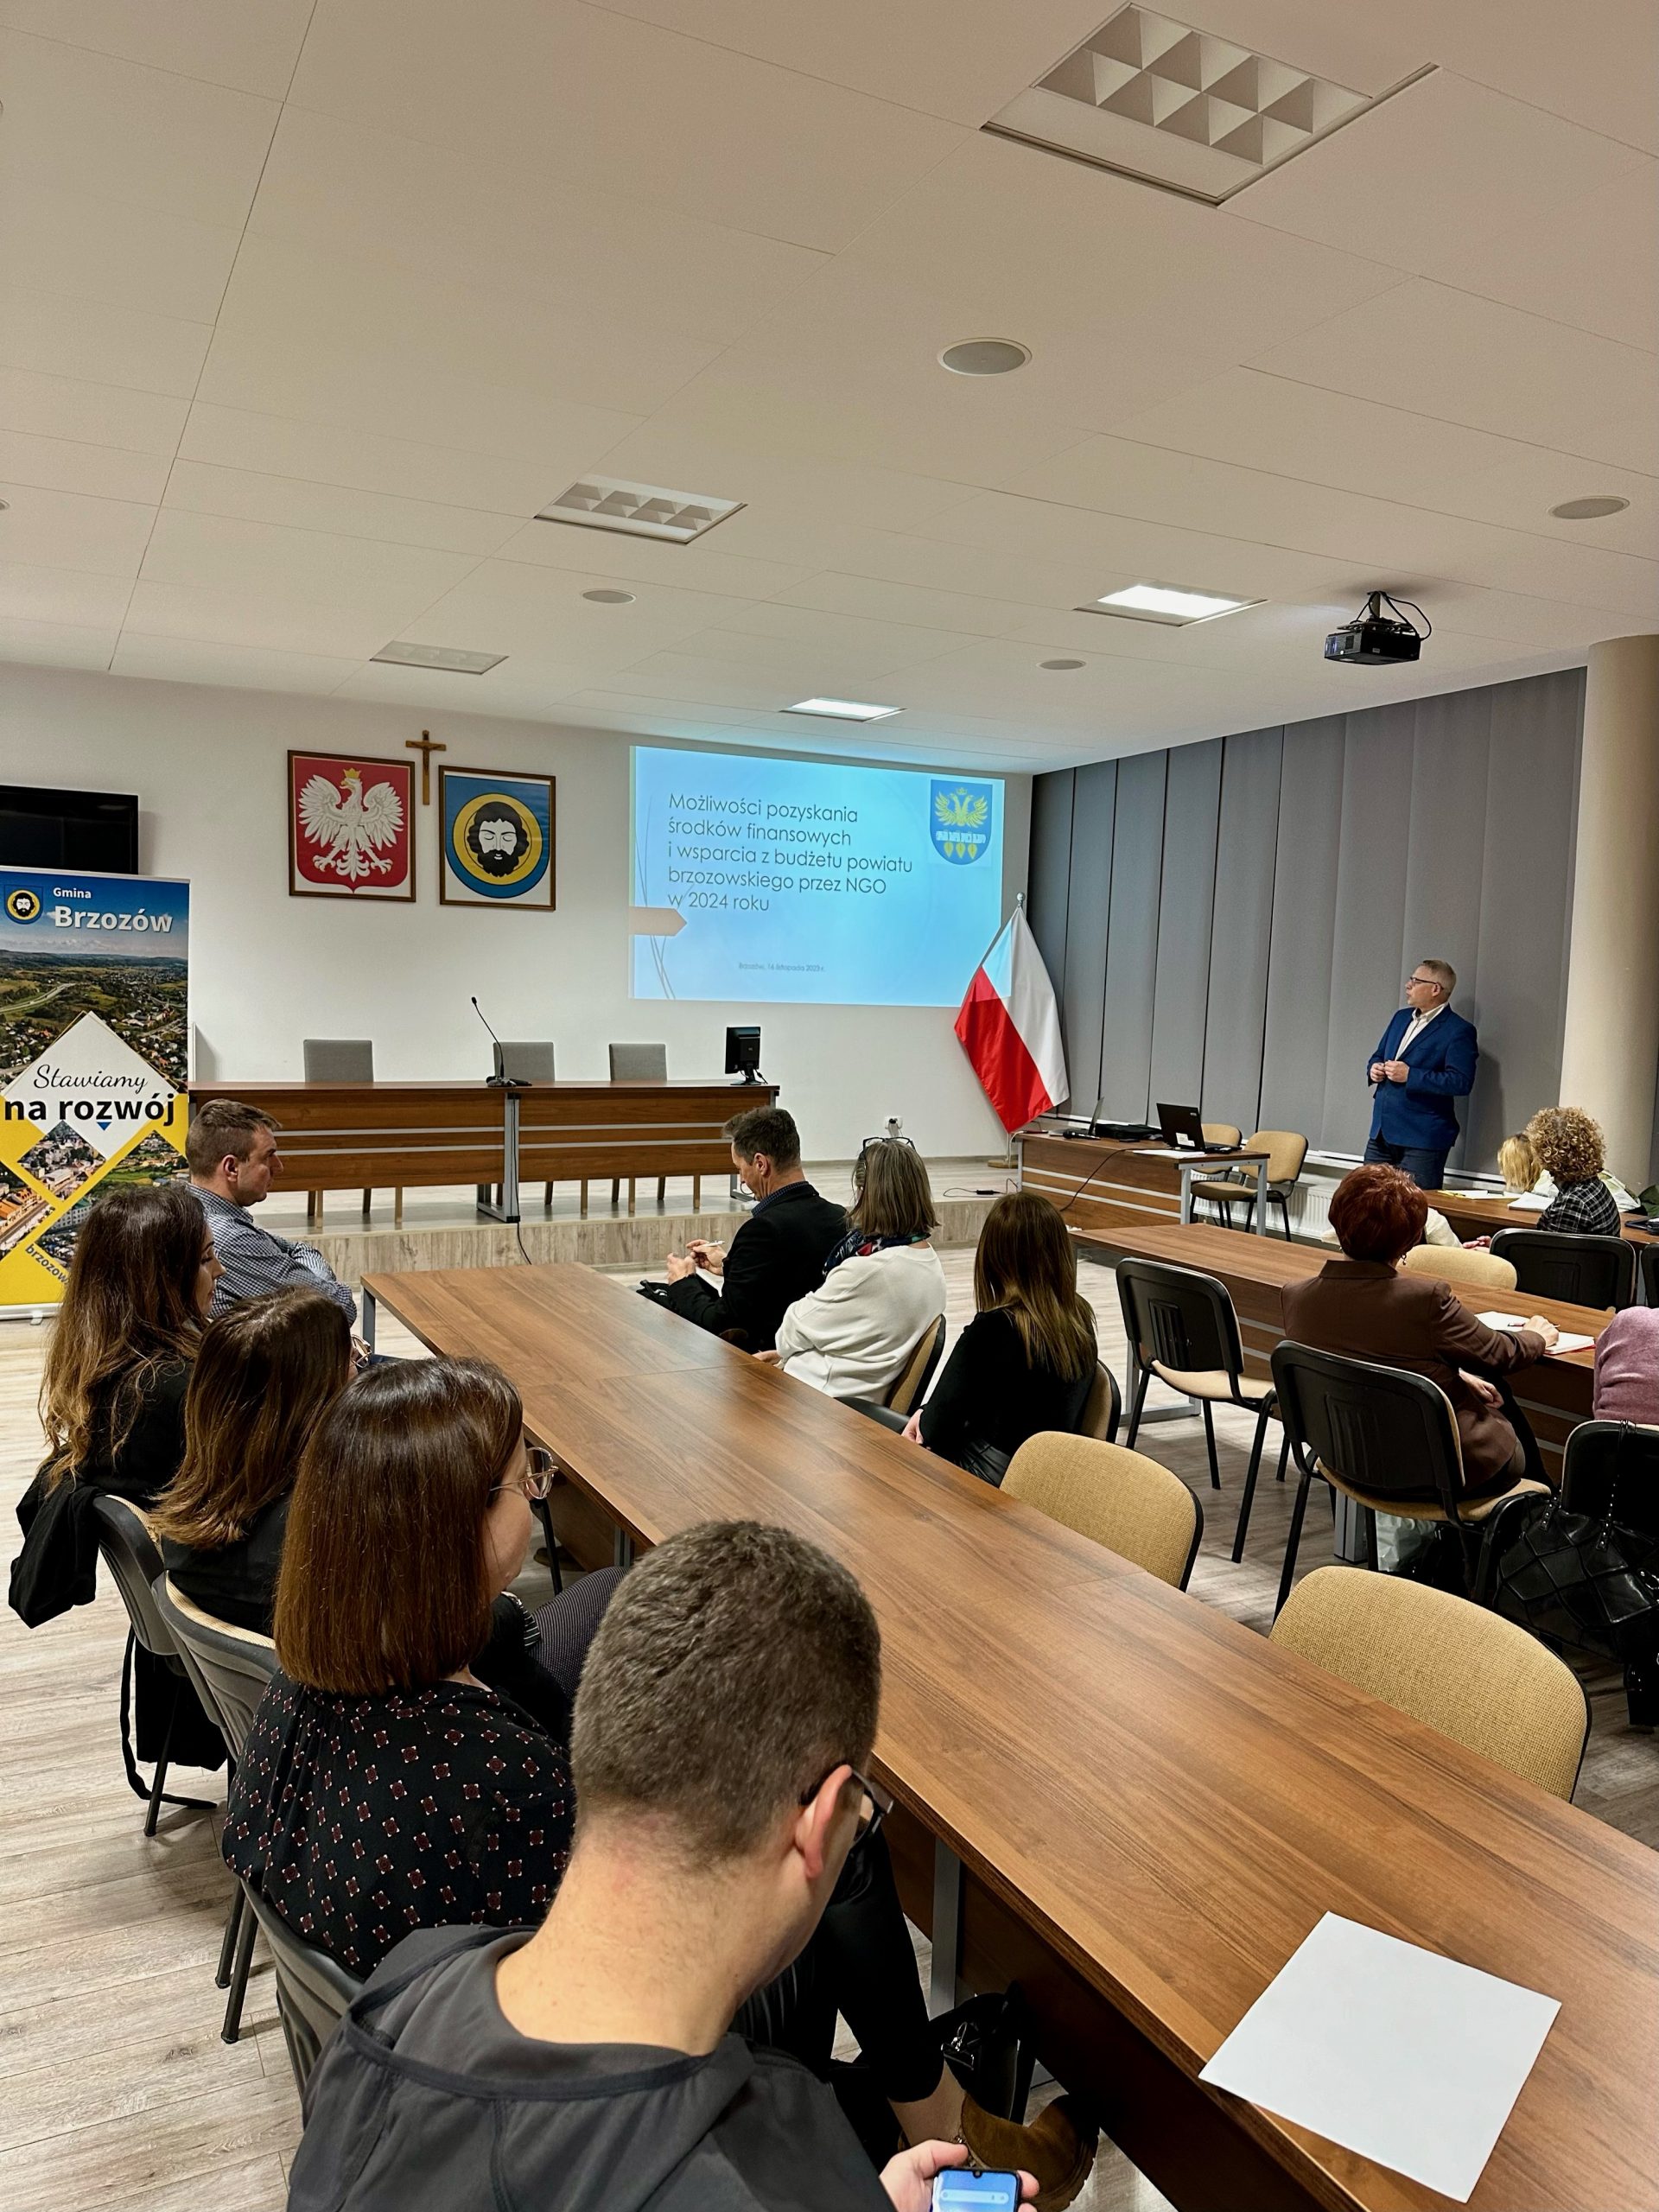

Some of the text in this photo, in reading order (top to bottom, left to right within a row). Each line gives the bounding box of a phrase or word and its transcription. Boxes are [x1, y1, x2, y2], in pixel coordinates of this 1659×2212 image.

[669, 792, 857, 822] Możliwości pozyskania
[668, 817, 851, 848] środków finansowych
[668, 841, 912, 873] i wsparcia z budżetu powiatu
[53, 887, 92, 899] Gmina
[669, 866, 887, 894] brzozowskiego przez NGO
[668, 892, 769, 912] w 2024 roku
[54, 905, 173, 933] Brzozów
[33, 1064, 148, 1093] Stawiamy
[4, 1093, 175, 1126] na rozwój
